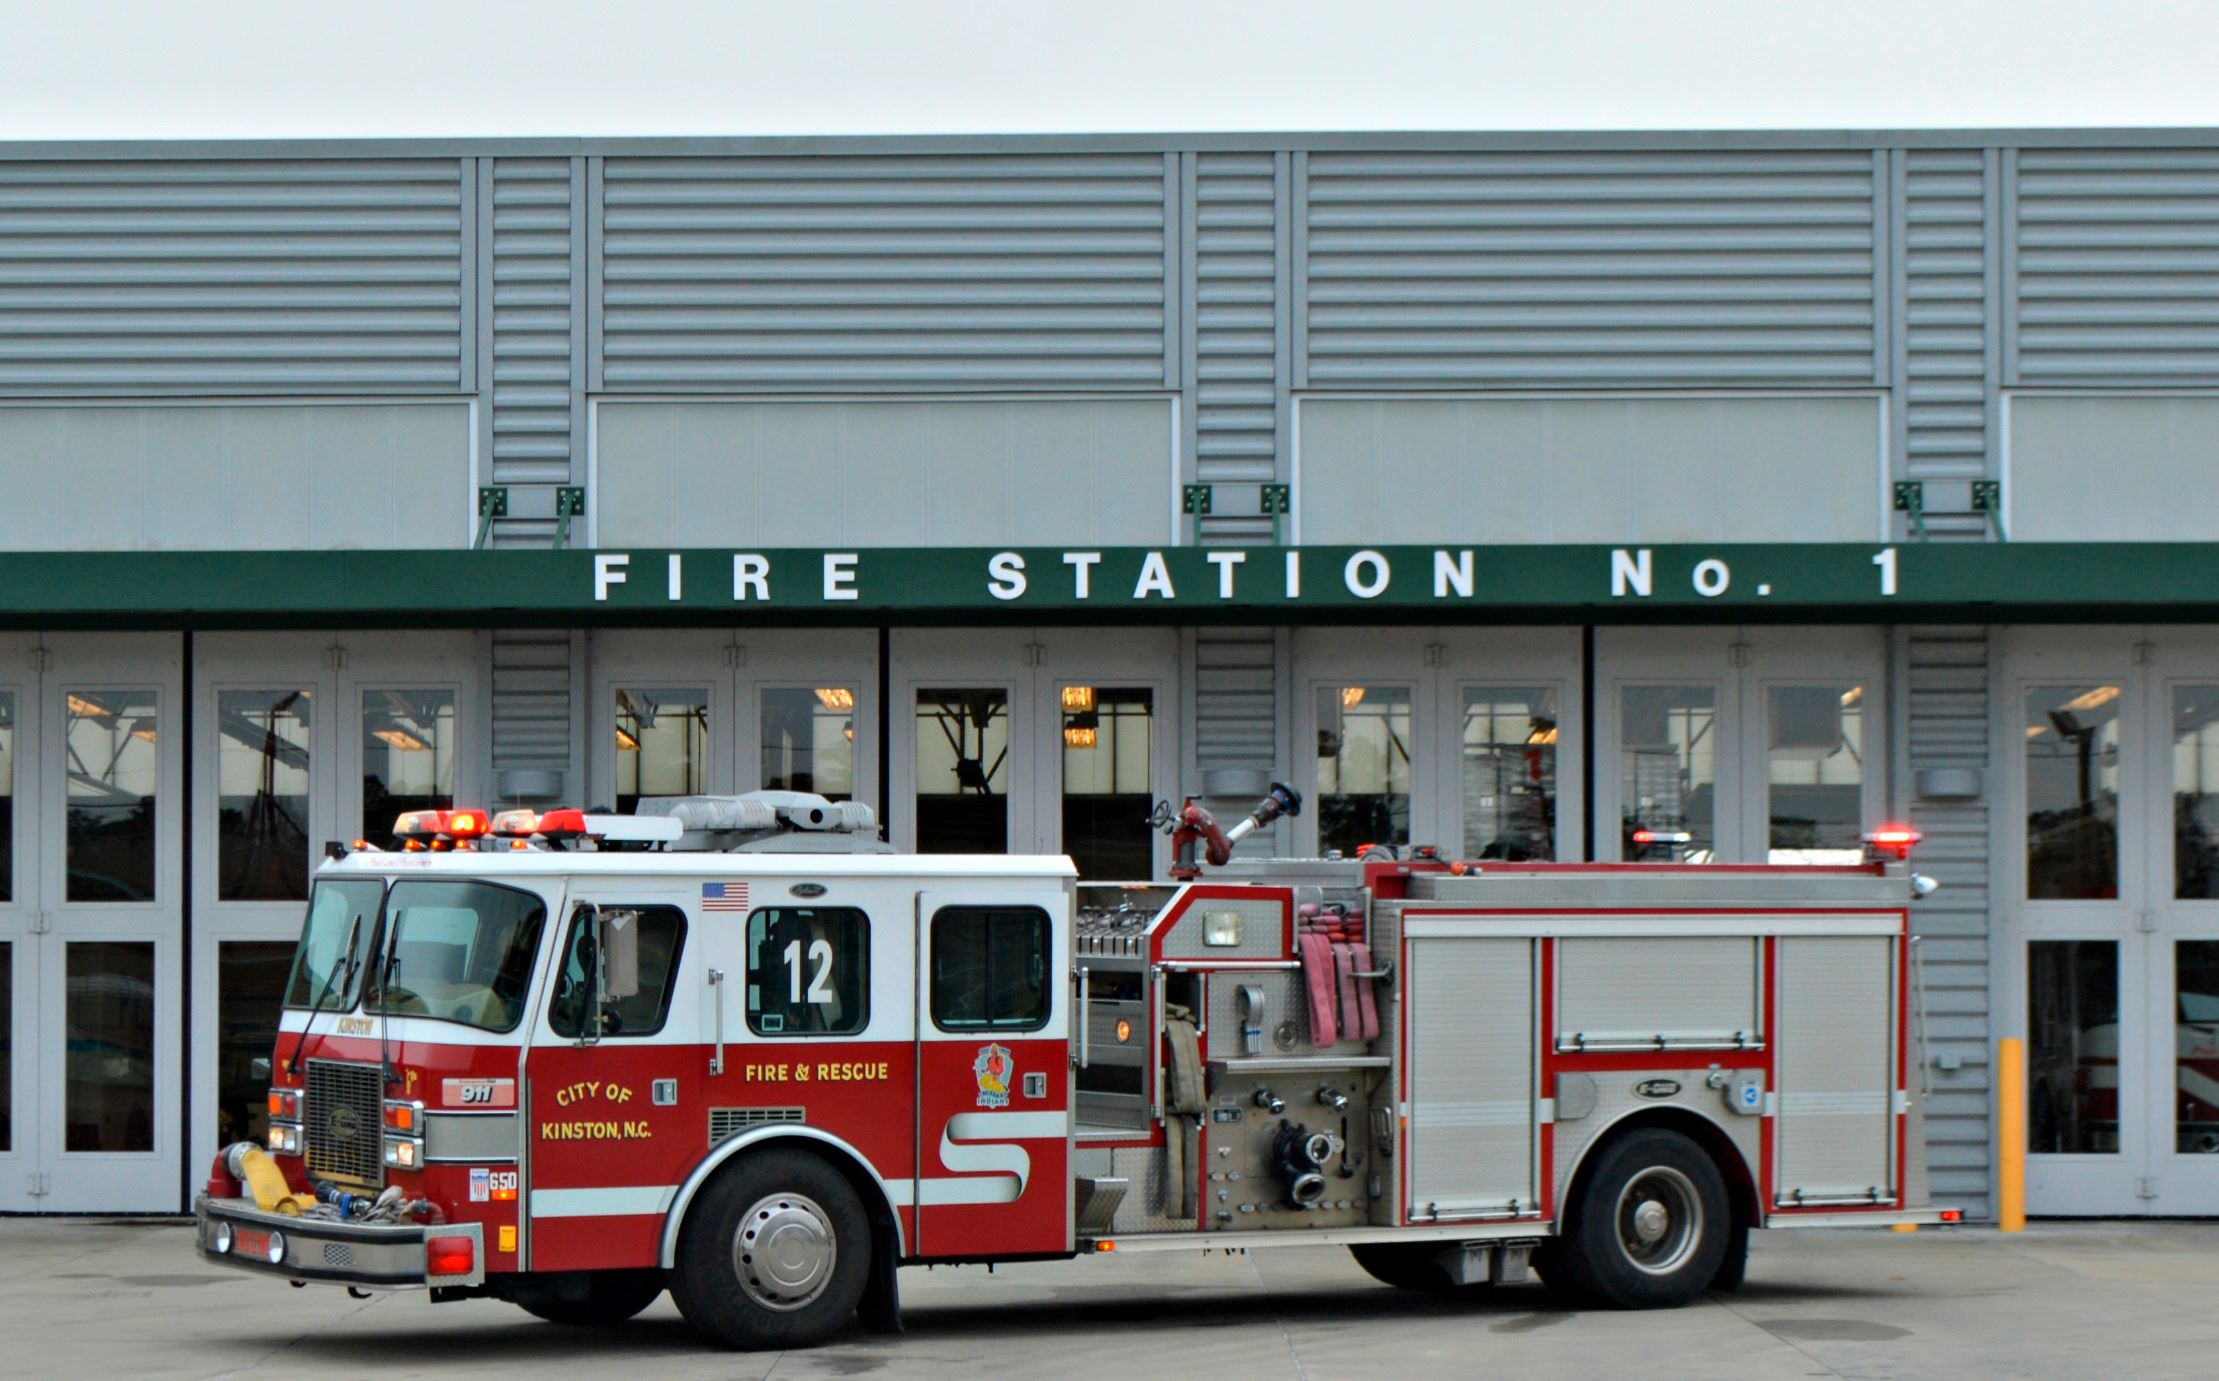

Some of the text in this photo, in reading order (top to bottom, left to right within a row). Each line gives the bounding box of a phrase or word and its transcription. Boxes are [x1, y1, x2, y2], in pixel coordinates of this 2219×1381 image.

[594, 547, 1897, 601] FIRE STATION No. 1
[783, 939, 833, 1004] 12
[745, 1062, 889, 1082] FIRE & RESCUE
[461, 1085, 493, 1104] 911
[556, 1081, 634, 1107] CITY OF
[542, 1121, 652, 1140] KINSTON, N.C.
[490, 1172, 517, 1190] 650
